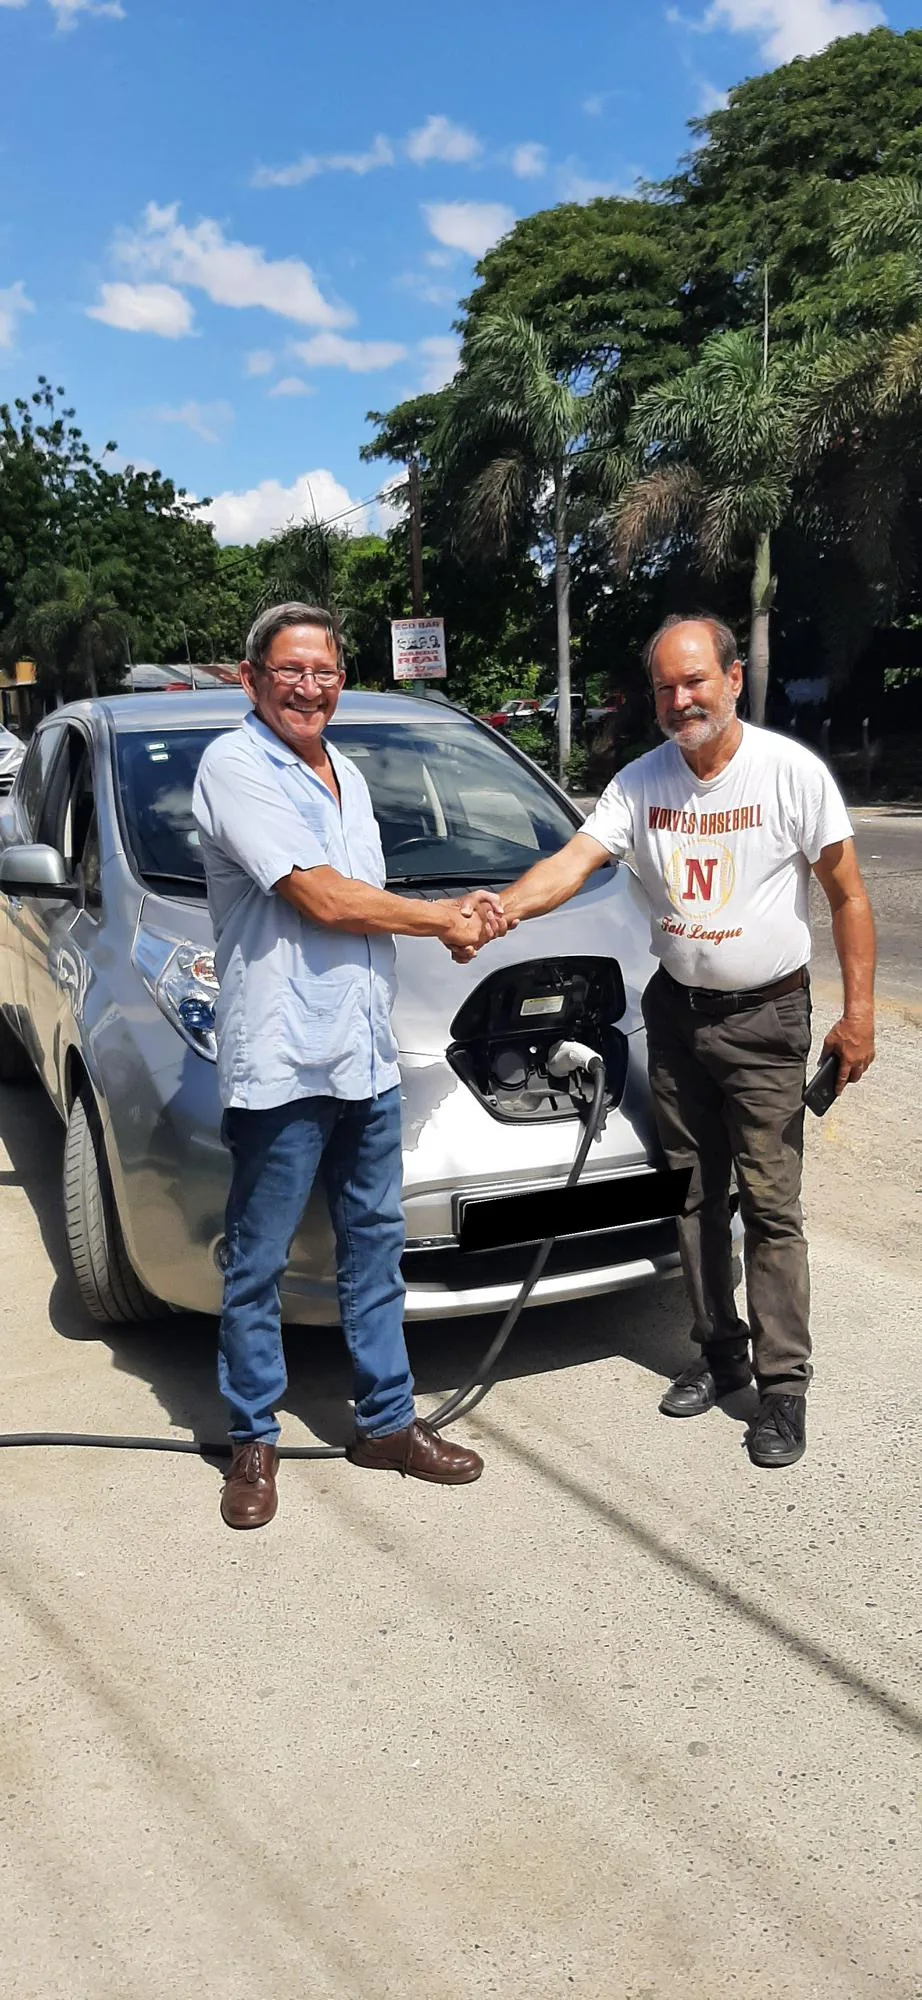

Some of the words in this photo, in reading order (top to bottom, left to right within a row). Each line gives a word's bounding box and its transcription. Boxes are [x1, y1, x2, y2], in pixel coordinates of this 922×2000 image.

[395, 622, 416, 630] ECO
[418, 621, 440, 629] BAR
[398, 656, 440, 664] REAL
[648, 806, 696, 835] WOLVES
[700, 804, 763, 836] BASEBALL
[682, 858, 718, 901] N
[661, 916, 687, 938] Fall
[687, 923, 743, 946] League
